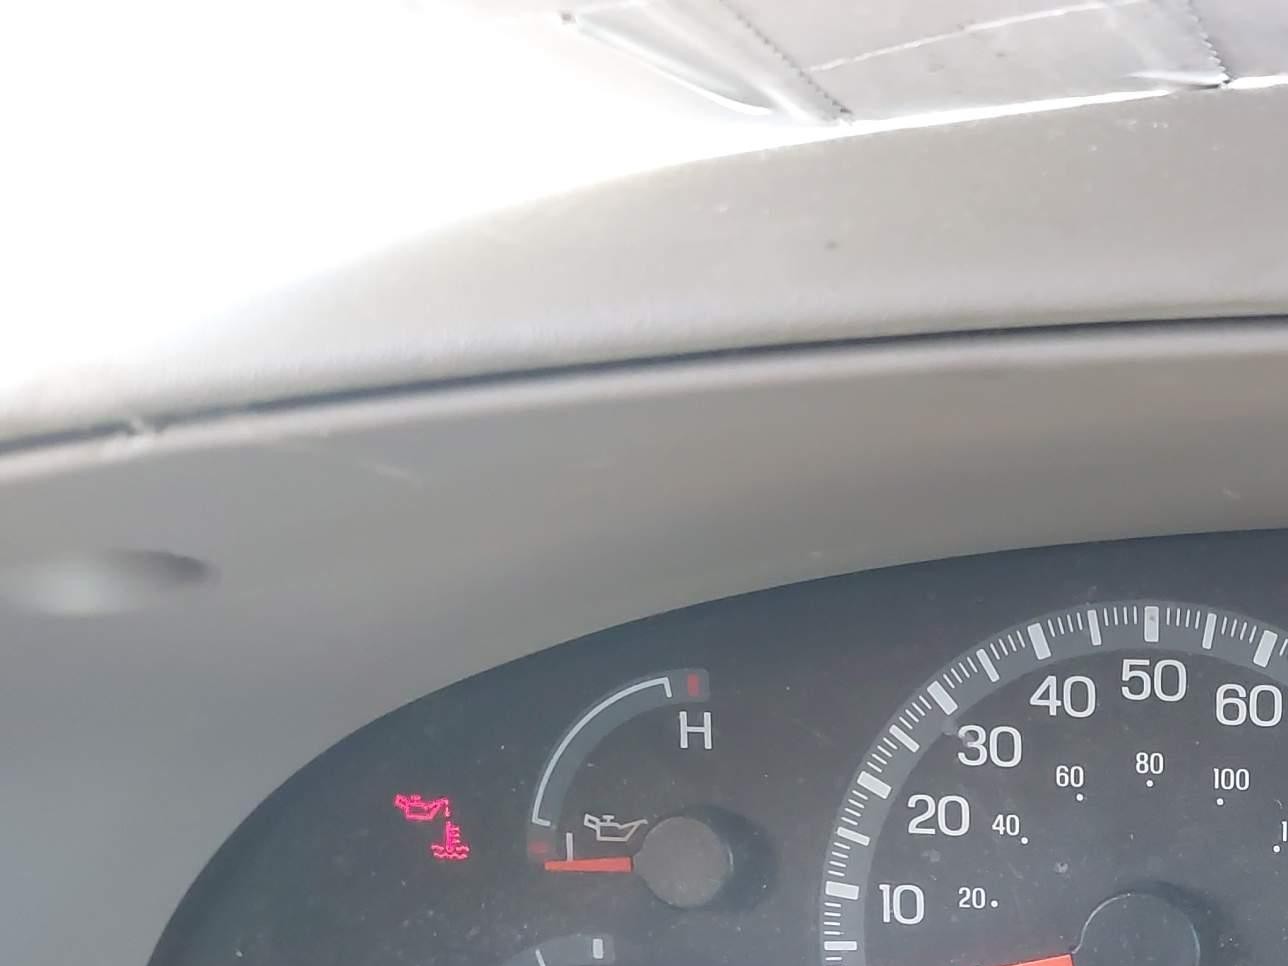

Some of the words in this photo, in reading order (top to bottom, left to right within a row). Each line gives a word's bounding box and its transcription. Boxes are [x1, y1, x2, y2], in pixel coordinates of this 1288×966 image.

[1030, 676, 1095, 717] 40
[1122, 659, 1186, 701] 50
[1216, 684, 1282, 726] 60
[680, 712, 711, 749] H
[958, 725, 1021, 767] 30
[1056, 766, 1083, 787] 60
[1136, 753, 1163, 774] 80
[1214, 768, 1249, 790] 100
[908, 795, 969, 835] 20
[992, 815, 1019, 835] 40
[879, 885, 924, 924] 10
[959, 887, 985, 908] 20
